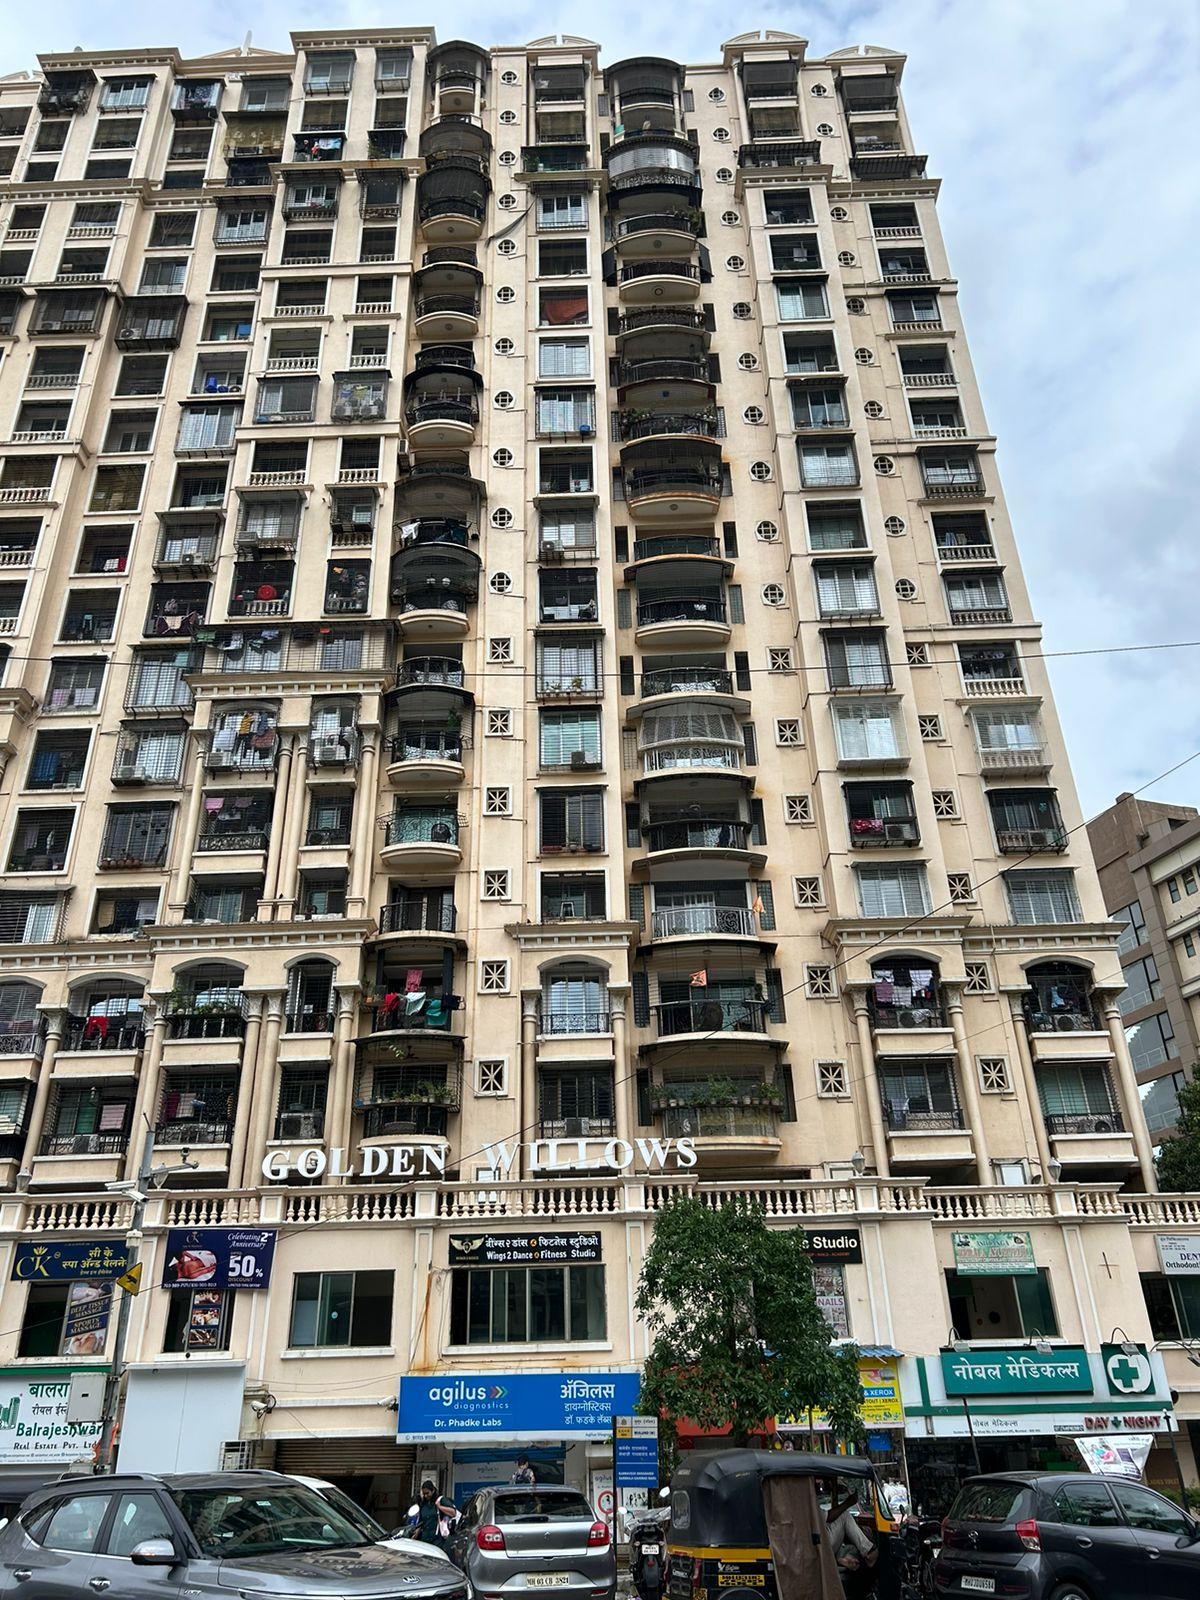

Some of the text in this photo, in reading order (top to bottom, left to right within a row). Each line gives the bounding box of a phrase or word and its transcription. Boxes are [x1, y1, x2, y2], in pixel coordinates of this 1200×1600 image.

[261, 1137, 698, 1180] GOLDEN WILLOWS
[227, 1232, 260, 1242] Celebrating
[813, 1236, 857, 1249] Studio
[228, 1241, 266, 1250] Anniversary
[486, 1251, 507, 1262] Wings
[507, 1251, 512, 1259] 2
[512, 1251, 533, 1259] Dance
[540, 1249, 567, 1259] Fitness
[571, 1248, 596, 1258] Studio
[16, 1256, 52, 1277] CK
[816, 1298, 844, 1306] NAILS
[952, 1356, 1080, 1380] नोबल मेडिकल्स
[29, 1383, 70, 1398] बालरा
[429, 1380, 486, 1407] agilus
[454, 1401, 509, 1411] diagnostics
[434, 1418, 502, 1427] Dr. Phadke Labs
[576, 1413, 596, 1425] फडके
[1084, 1417, 1110, 1429] DAY
[1123, 1415, 1161, 1428] NIGHT
[16, 1422, 104, 1440] Balrajeshwar
